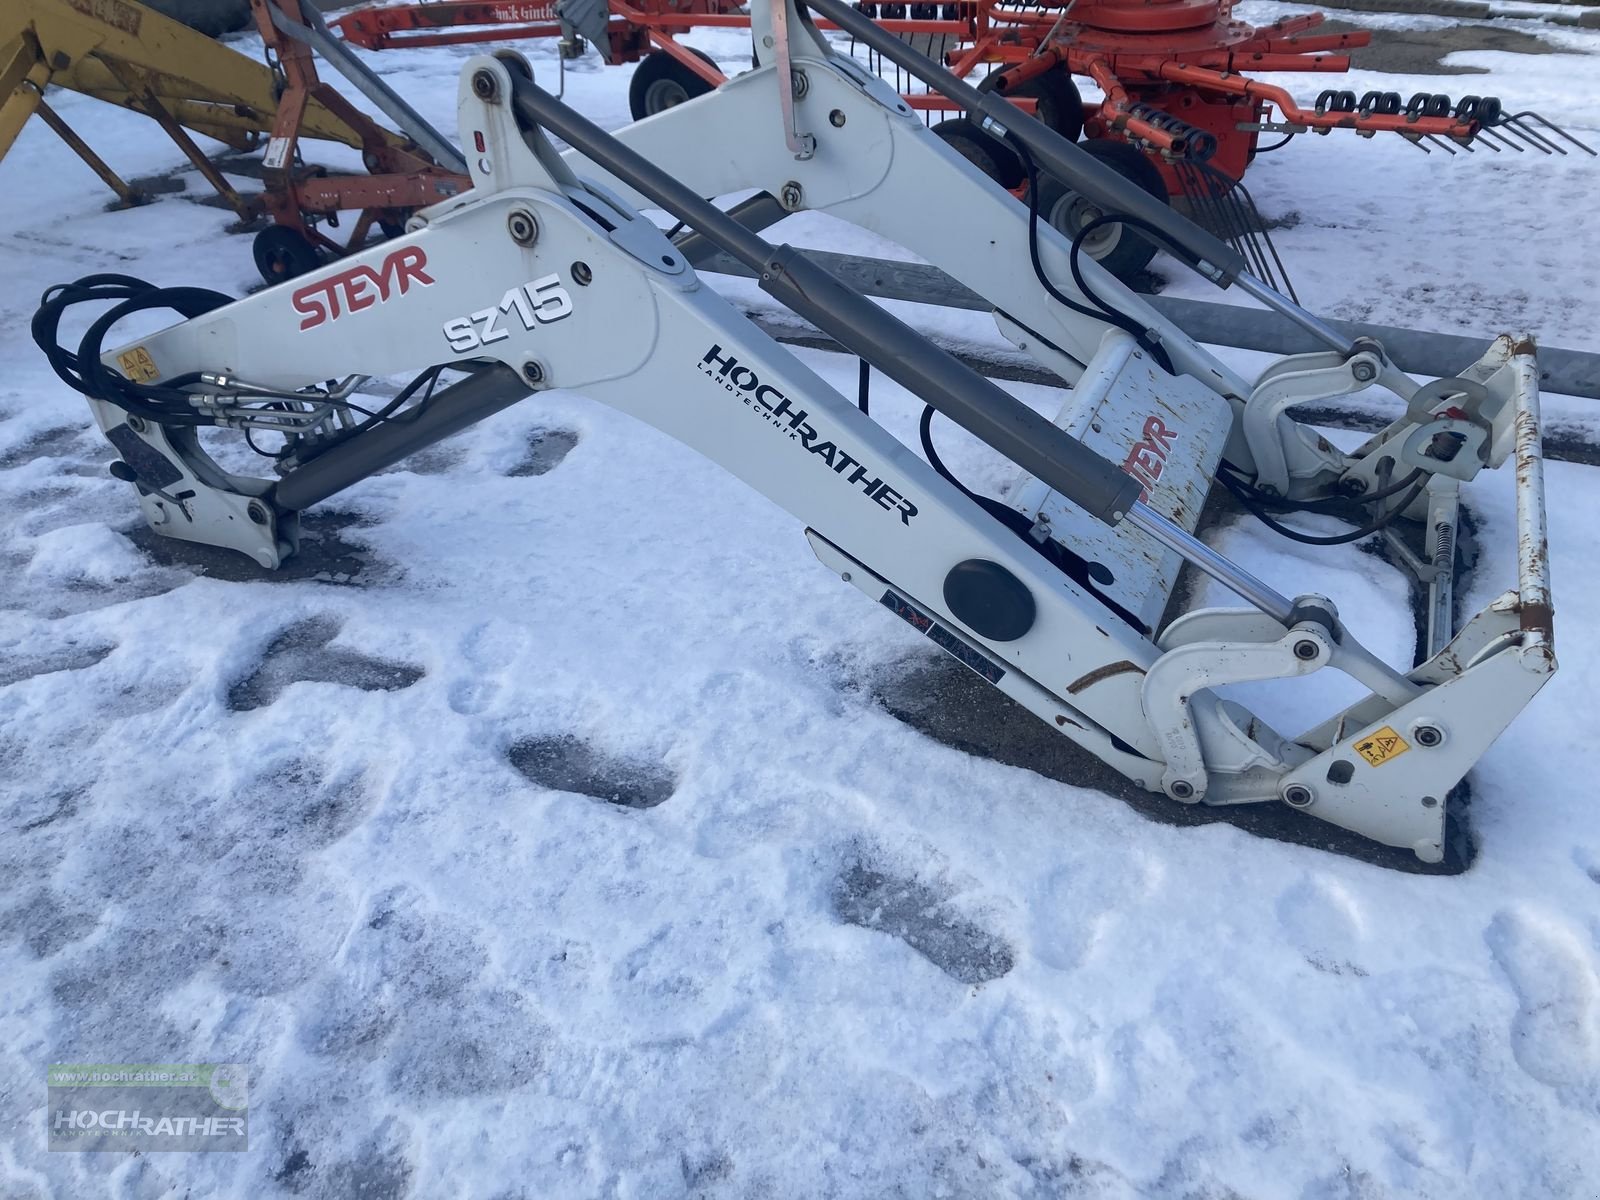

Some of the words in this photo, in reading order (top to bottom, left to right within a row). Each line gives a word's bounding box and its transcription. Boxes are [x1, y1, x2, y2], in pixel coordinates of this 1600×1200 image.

[292, 245, 436, 331] STEYR
[697, 362, 798, 440] LANDTECHNIK
[702, 344, 919, 527] HOCHRATHER
